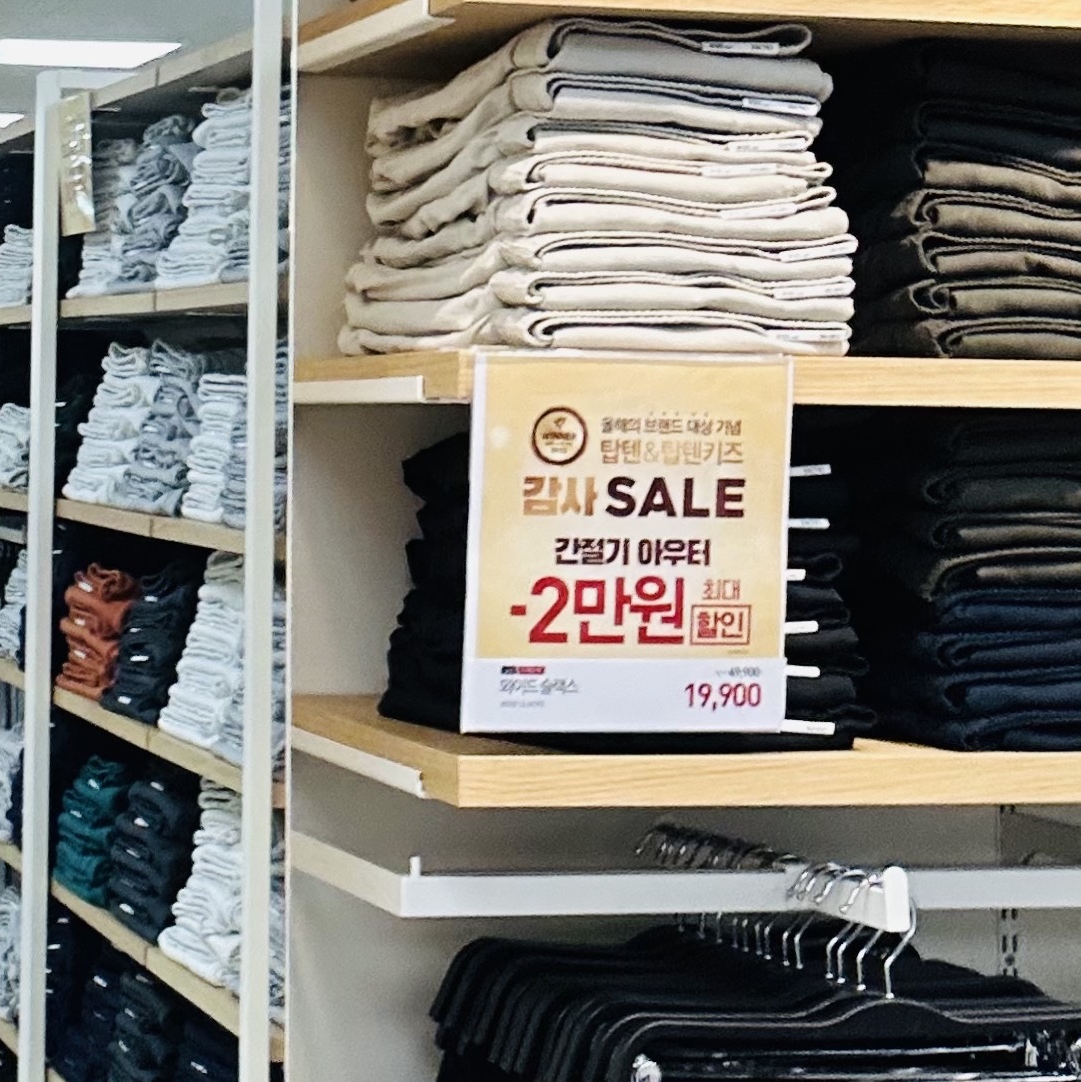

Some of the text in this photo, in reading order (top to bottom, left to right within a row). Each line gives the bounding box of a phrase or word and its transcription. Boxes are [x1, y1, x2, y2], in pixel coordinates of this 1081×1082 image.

[644, 418, 683, 434] 브랜드
[716, 419, 742, 436] 기념
[523, 476, 746, 518] 감사 SALE
[555, 538, 711, 567] 간절기 아우터
[702, 579, 741, 601] 최대
[510, 576, 684, 645] -2만원
[697, 611, 744, 638] 할인
[684, 682, 762, 712] 19,900
